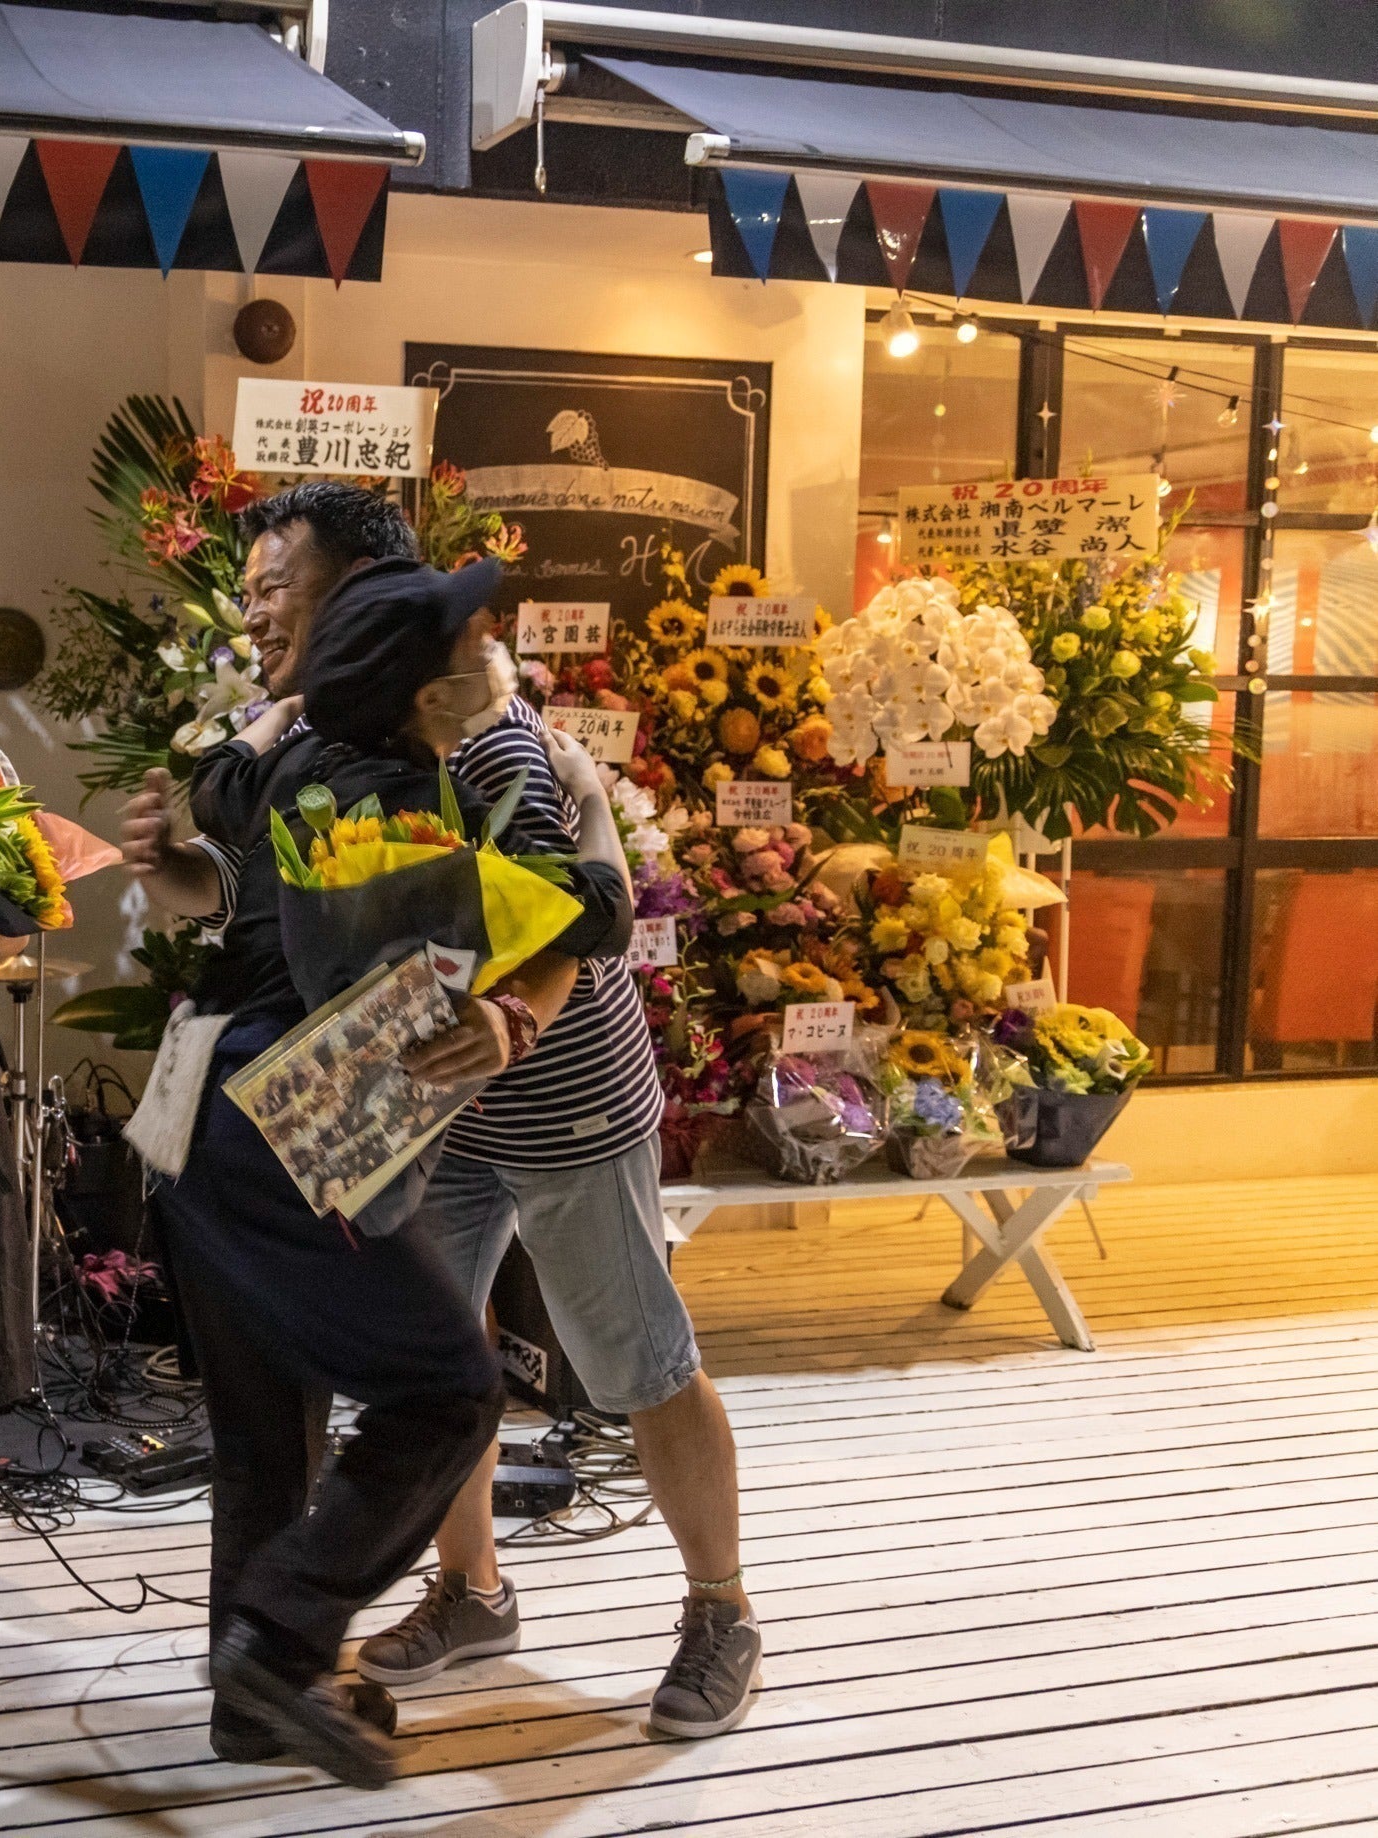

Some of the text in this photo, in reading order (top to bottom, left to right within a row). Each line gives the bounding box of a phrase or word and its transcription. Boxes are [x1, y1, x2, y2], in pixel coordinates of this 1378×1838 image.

[255, 417, 292, 430] 株式会社
[292, 435, 412, 471] 豊川忠紀
[905, 494, 1145, 524] 株式会社 湘南ベルマーレ
